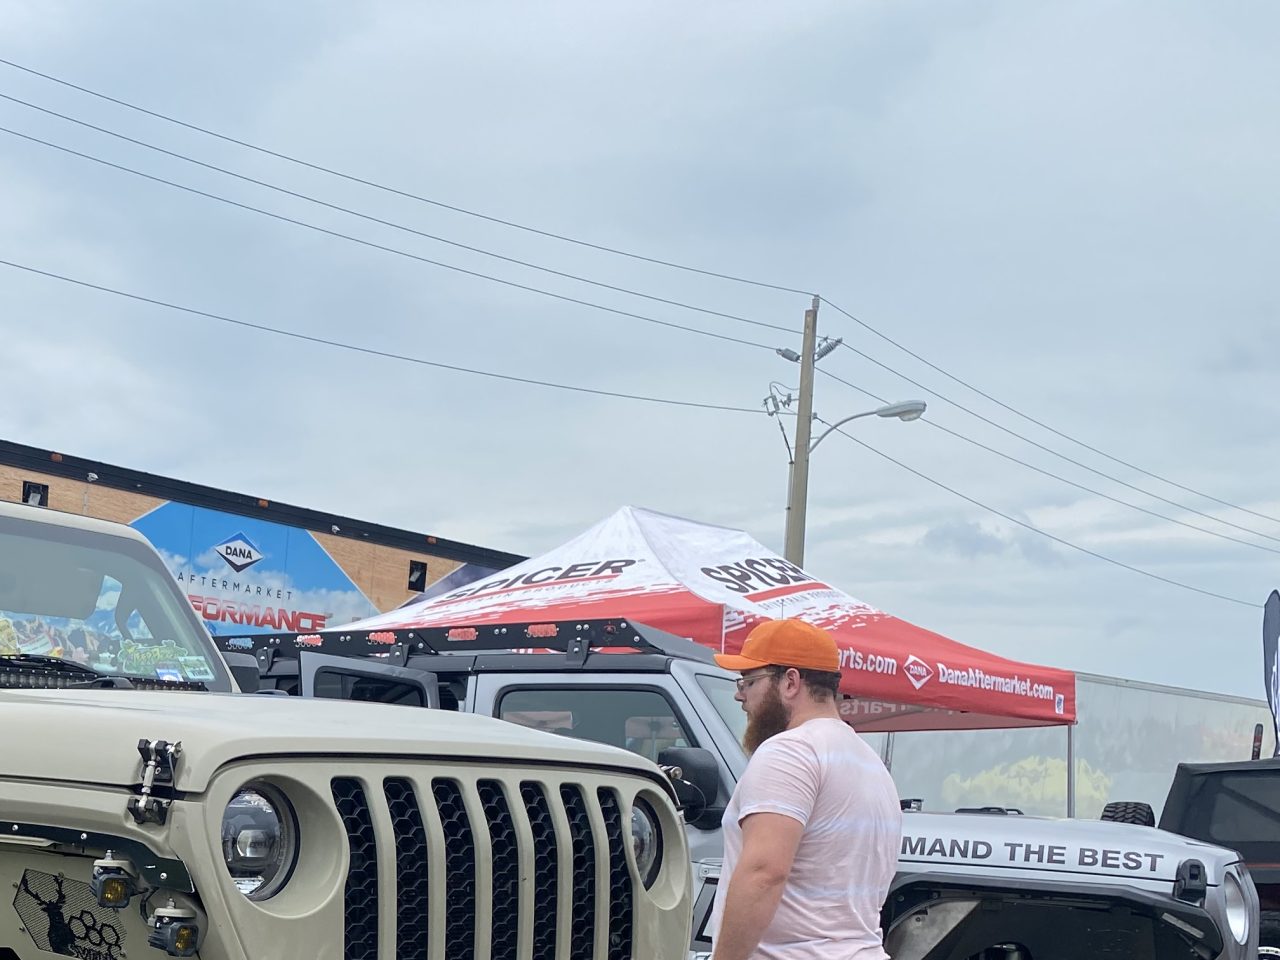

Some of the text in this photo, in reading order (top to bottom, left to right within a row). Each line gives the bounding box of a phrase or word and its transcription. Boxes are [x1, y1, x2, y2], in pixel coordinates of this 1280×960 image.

[225, 545, 253, 560] DANA
[177, 571, 293, 600] AFTERMARKET
[434, 559, 636, 605] SPICER
[909, 664, 928, 678] DANA
[936, 662, 1054, 701] DanaAftermarket.com
[901, 836, 1165, 872] MAND THE BEST
